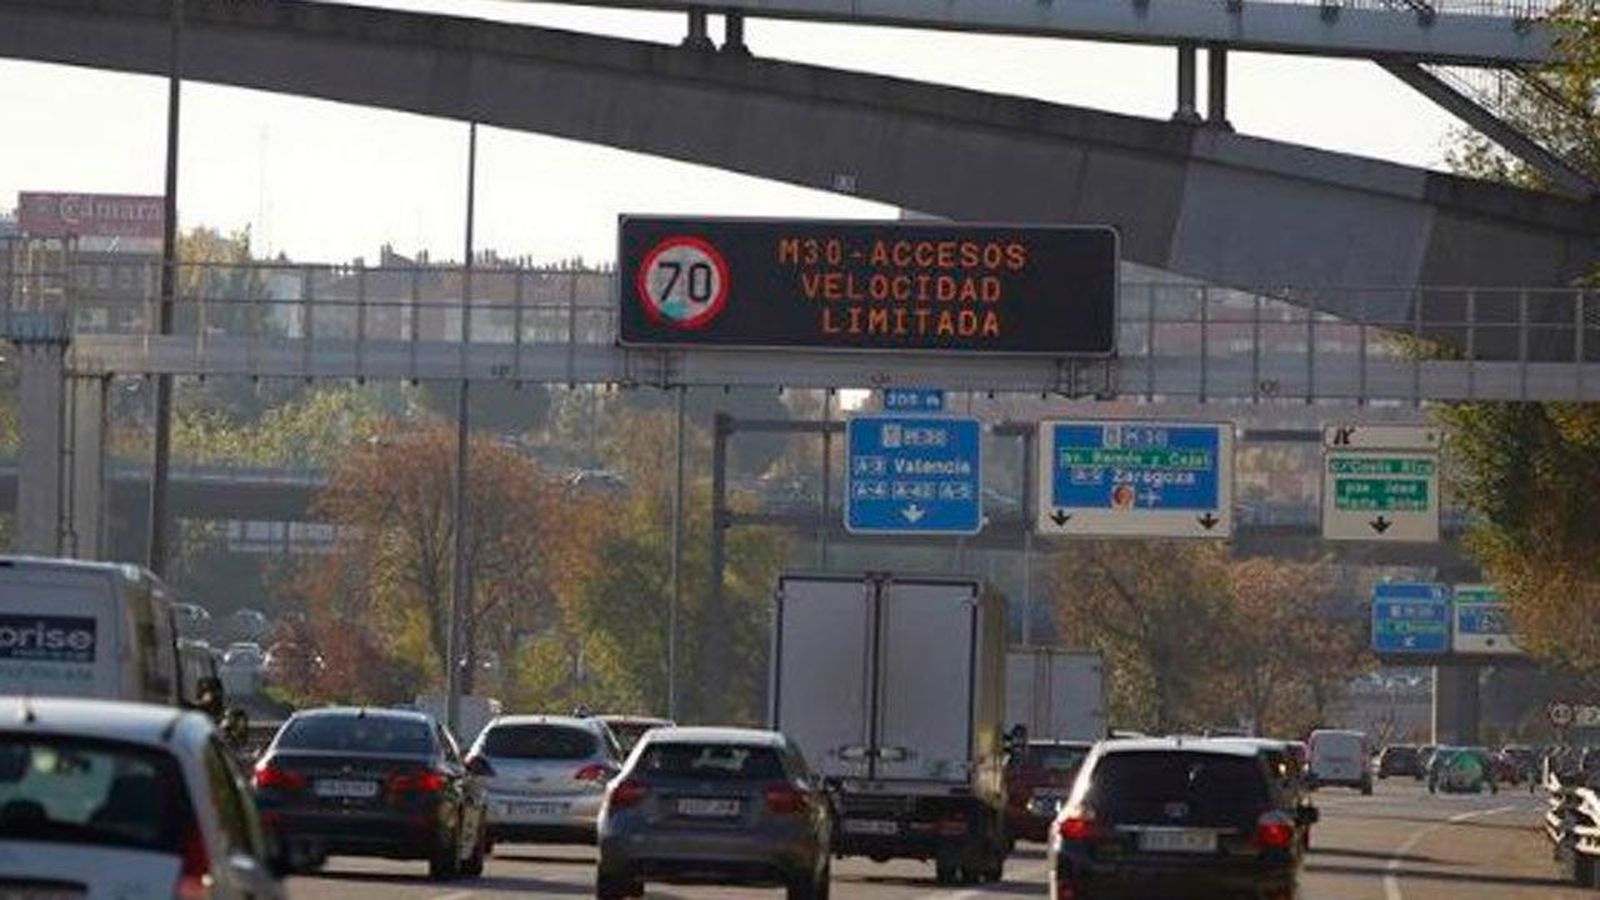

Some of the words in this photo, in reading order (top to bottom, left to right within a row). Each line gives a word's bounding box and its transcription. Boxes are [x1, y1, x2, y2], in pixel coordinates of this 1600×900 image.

[658, 261, 712, 303] 70
[802, 273, 1000, 302] VELOCIDAD
[823, 307, 999, 336] LIMITADA
[894, 458, 971, 476] Valencia
[1113, 468, 1196, 488] Zaragoza
